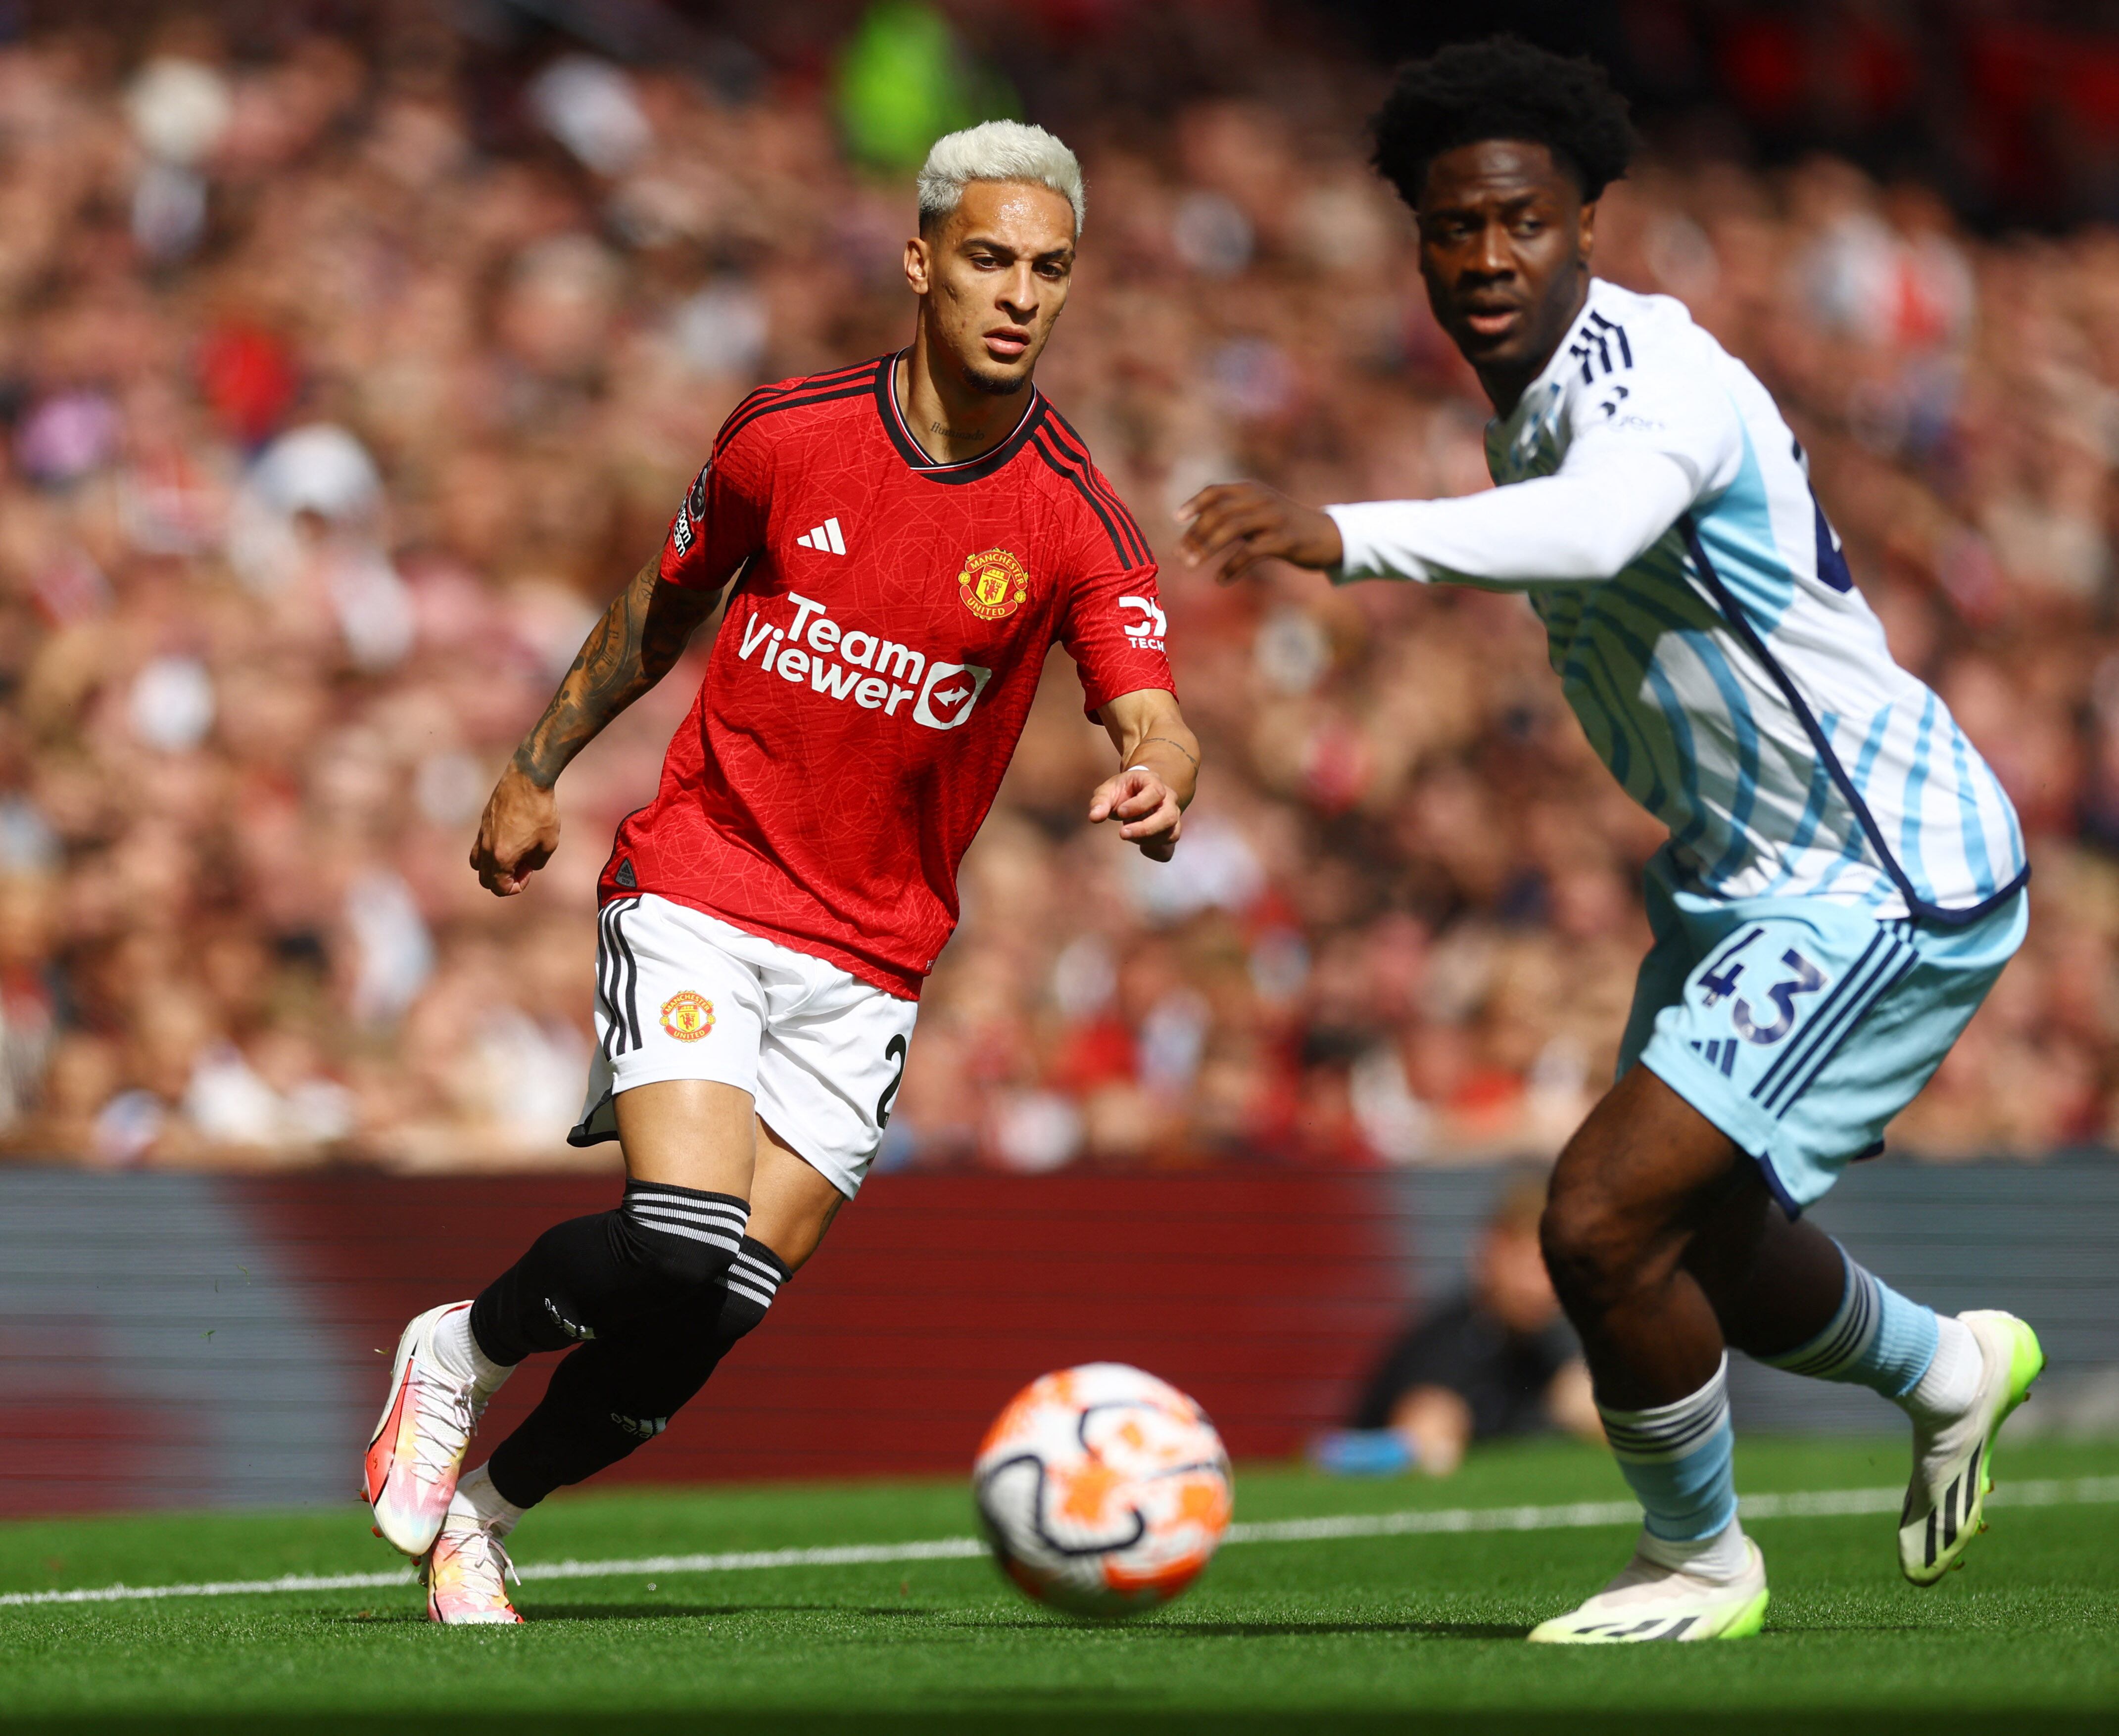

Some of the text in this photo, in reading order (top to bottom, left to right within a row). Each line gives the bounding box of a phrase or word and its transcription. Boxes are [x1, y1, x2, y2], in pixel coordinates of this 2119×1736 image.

[970, 554, 1024, 585] MANCHESTER
[967, 597, 1006, 615] UNITED
[787, 591, 925, 685] Team
[1128, 637, 1165, 653] TECH
[738, 611, 916, 716] Viewer
[1697, 928, 1829, 1045] 43
[665, 994, 710, 1013] MANCHESTER
[673, 1030, 705, 1039] UNITED
[876, 1033, 907, 1130] 2
